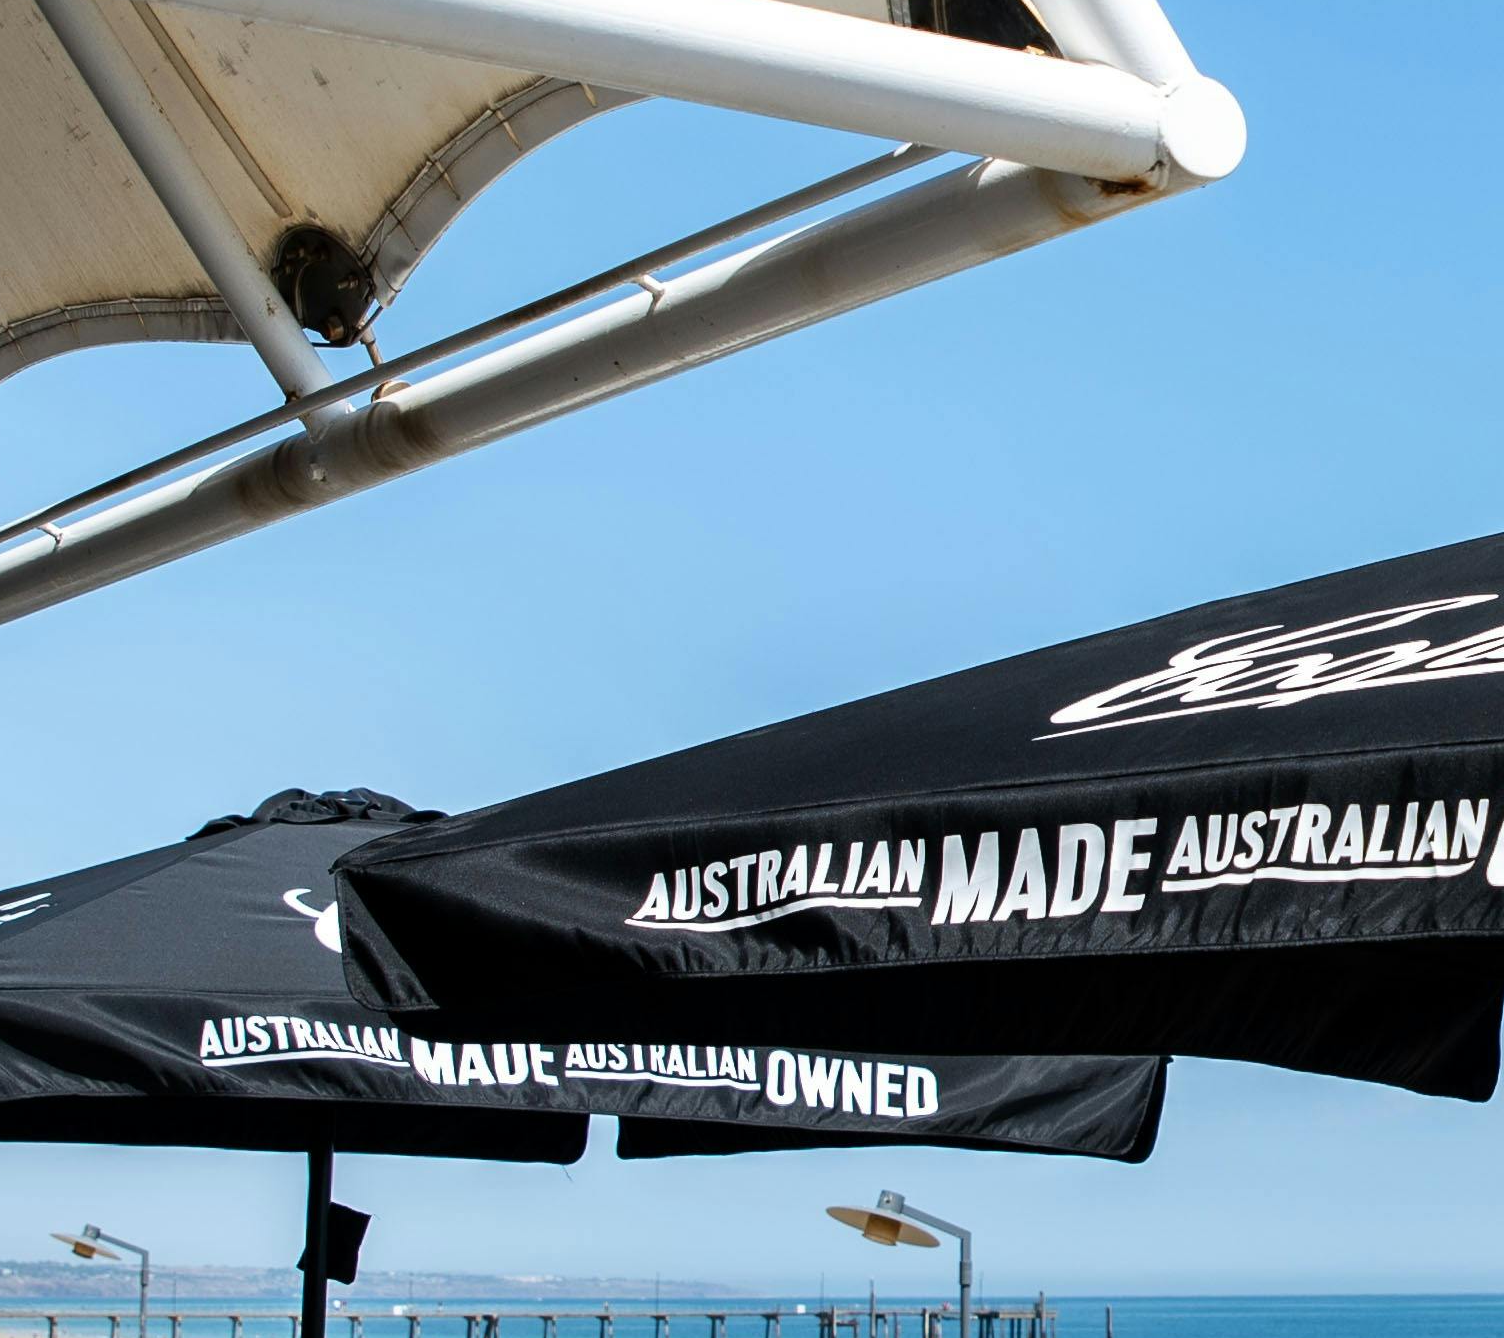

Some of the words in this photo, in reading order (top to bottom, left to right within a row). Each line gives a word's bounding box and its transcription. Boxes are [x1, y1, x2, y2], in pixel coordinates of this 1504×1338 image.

[631, 837, 926, 925] AUSTRALIAN
[930, 817, 1158, 926] MADE
[1168, 797, 1489, 883] AUSTRALIAN
[199, 1015, 403, 1059] AUSTRALIAN
[410, 1036, 559, 1088] MADE
[565, 1043, 758, 1083] AUSTRALIAN
[765, 1050, 939, 1118] OWNED
